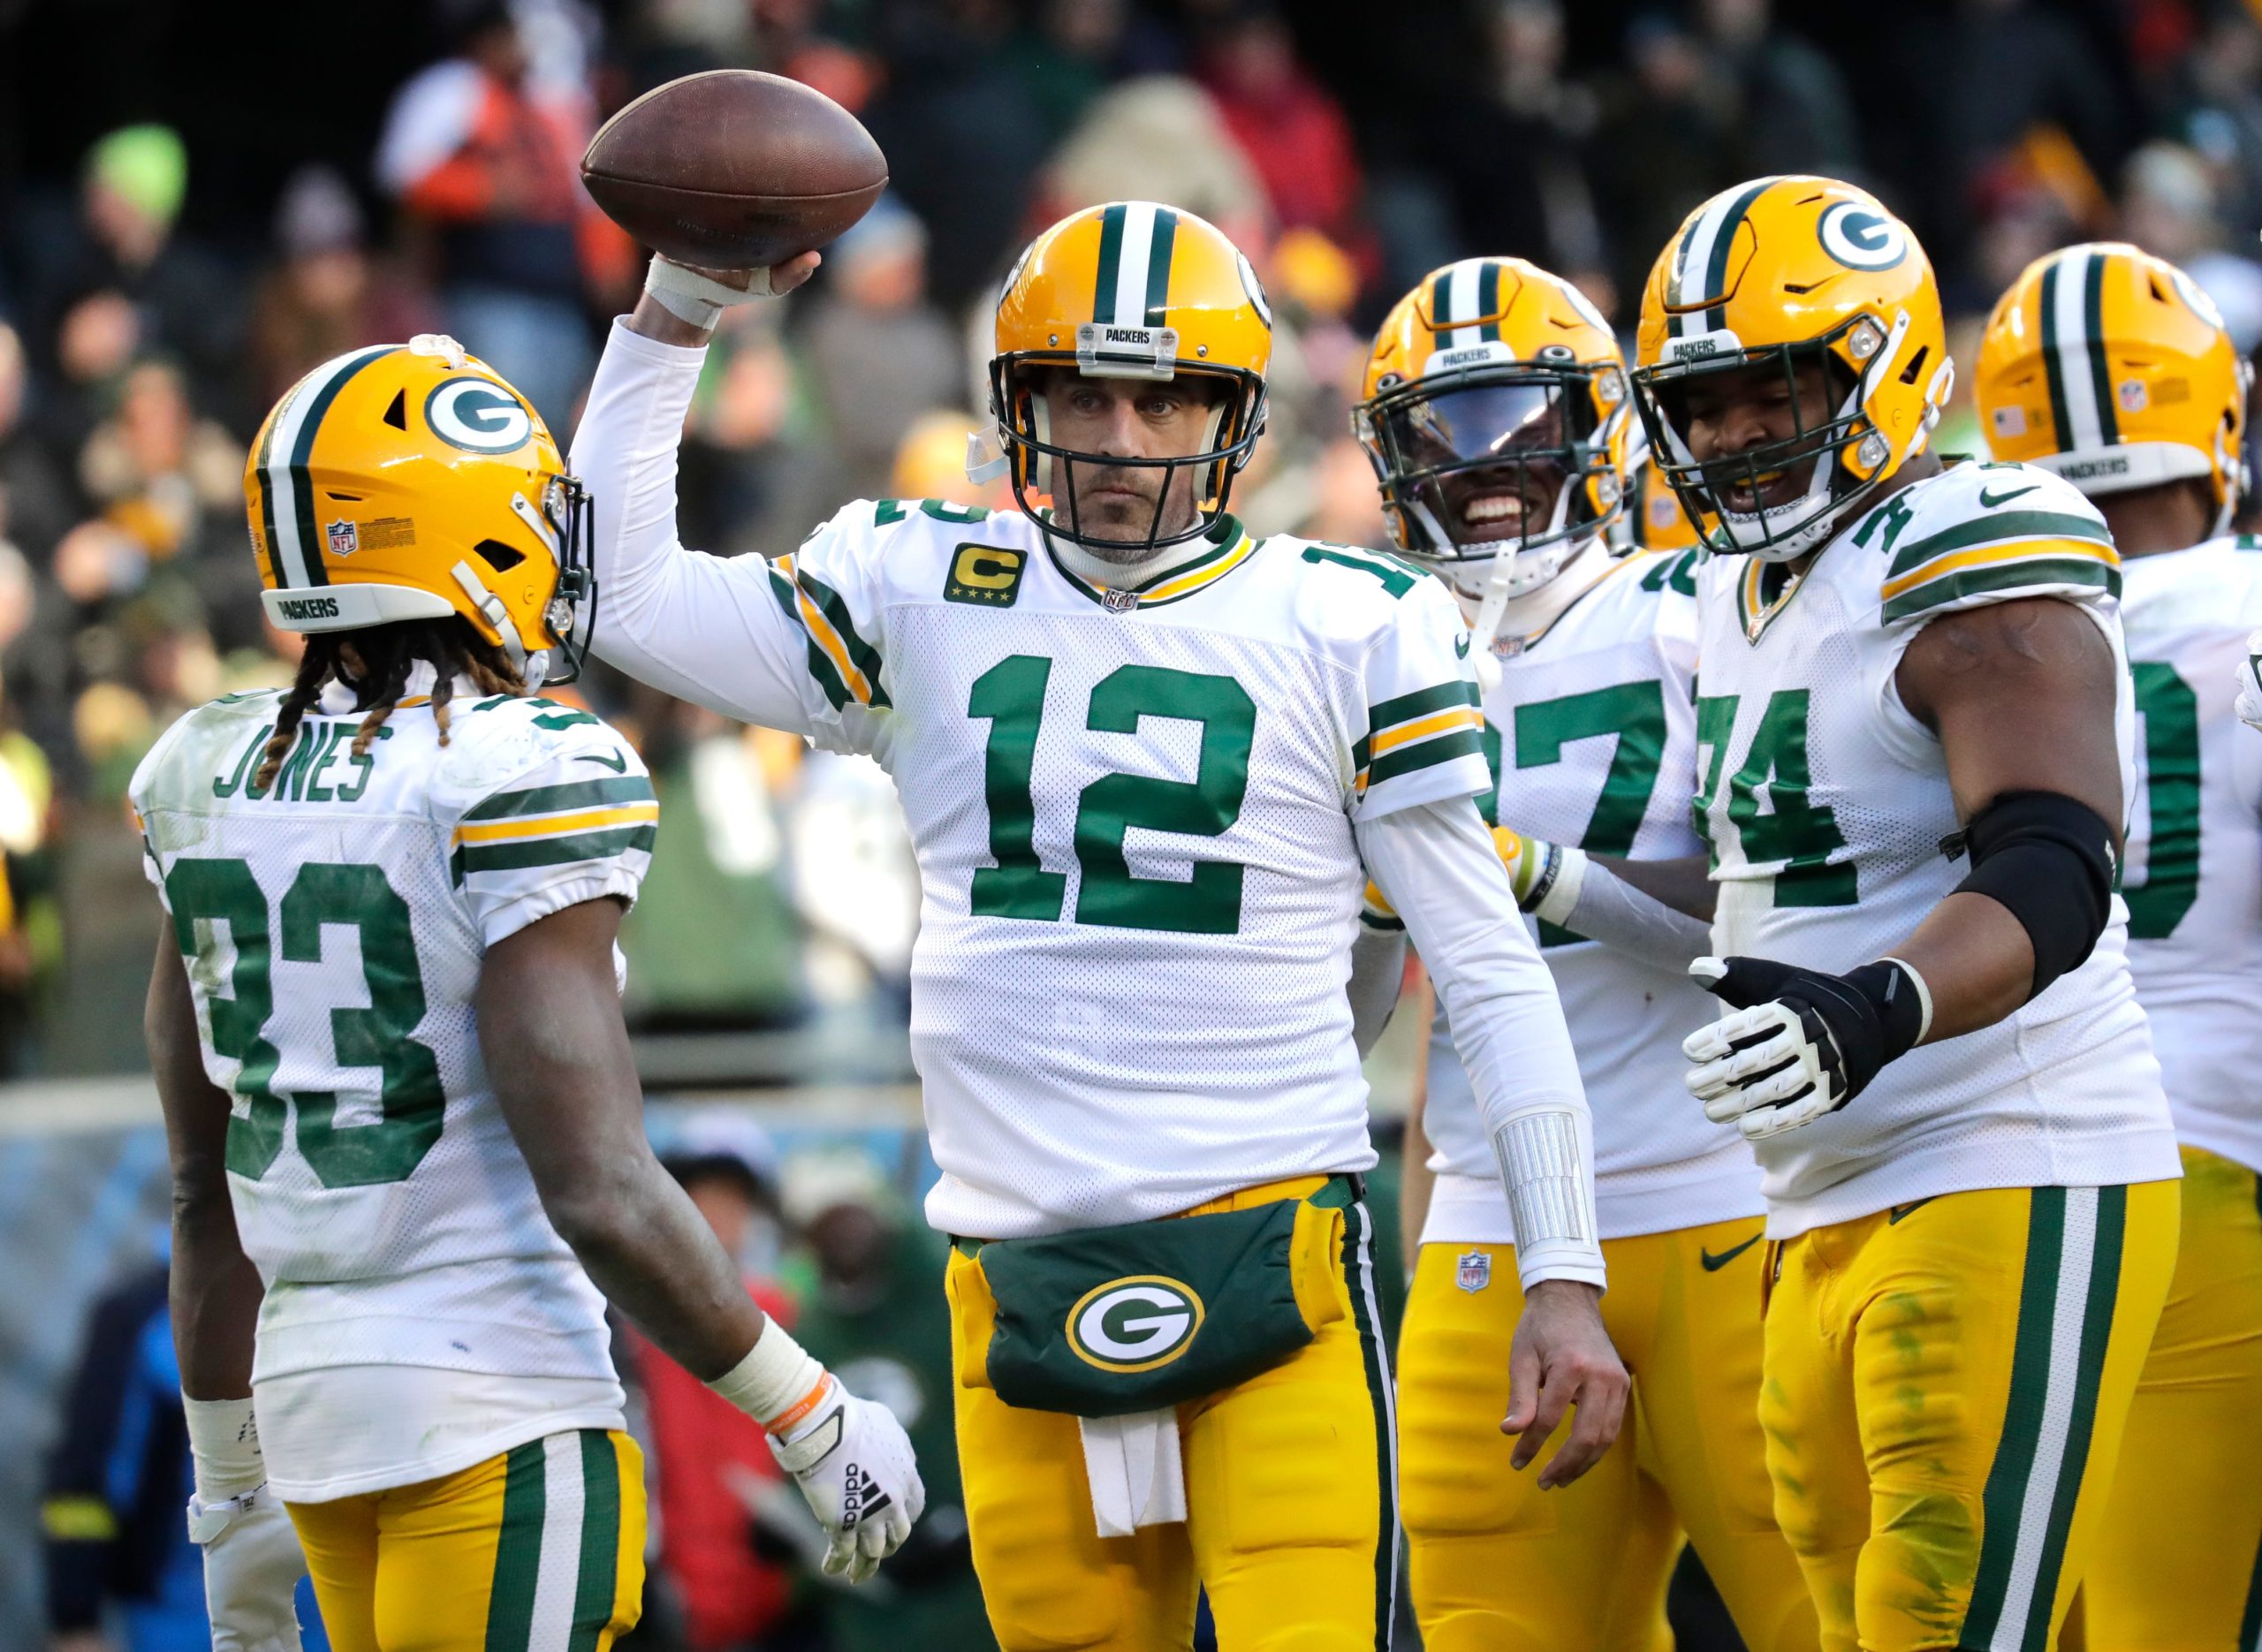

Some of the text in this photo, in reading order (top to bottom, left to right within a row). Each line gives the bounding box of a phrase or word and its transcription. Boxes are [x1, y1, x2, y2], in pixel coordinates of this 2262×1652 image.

[1105, 329, 1150, 345] PACKERS
[1673, 338, 1717, 359] PACKERS
[1442, 347, 1492, 368] PACKERS
[429, 379, 531, 451] G
[330, 535, 355, 550] NFL
[954, 547, 1021, 589] C
[277, 597, 339, 620] PACKERS
[1107, 595, 1132, 608] NFL
[968, 654, 1257, 935] 12
[164, 858, 446, 1189] 33
[1079, 1286, 1190, 1360] G
[842, 1463, 859, 1532] adidas
